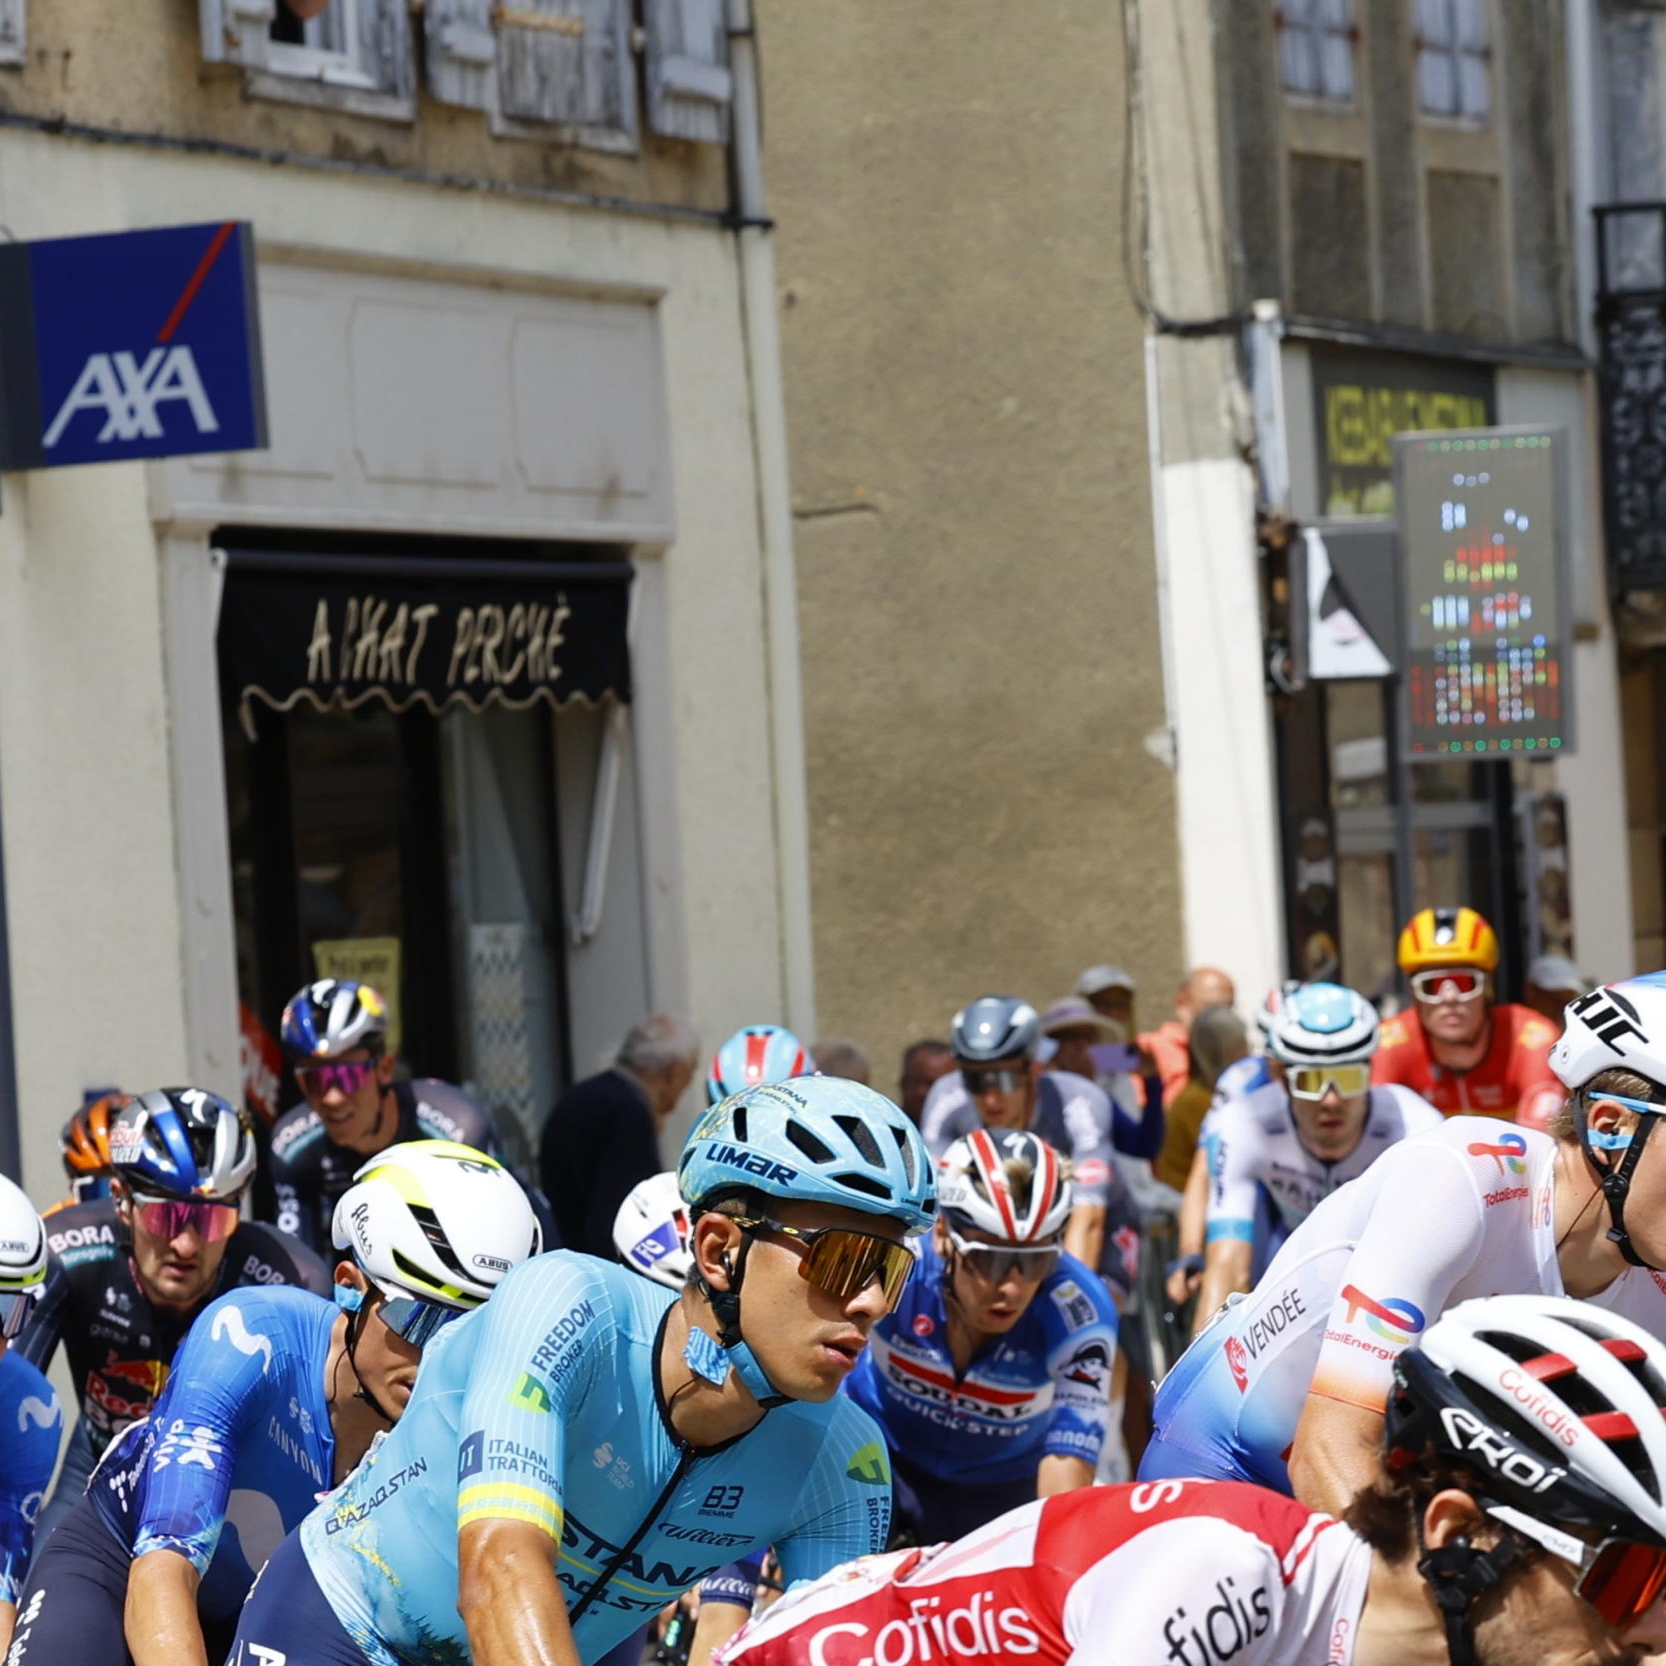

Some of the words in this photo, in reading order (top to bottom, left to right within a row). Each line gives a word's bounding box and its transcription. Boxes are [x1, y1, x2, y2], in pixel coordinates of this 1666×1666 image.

[43, 344, 220, 448] AXA
[307, 598, 332, 684] A
[1566, 985, 1650, 1059] HJC
[1481, 1186, 1531, 1208] TotalEnergies
[47, 1224, 117, 1255] BORA
[242, 1254, 288, 1286] BOR
[531, 1299, 596, 1372] FREEDOM
[1242, 1286, 1308, 1362] VENDÉE
[1325, 1327, 1401, 1362] otalEnergie
[549, 1339, 585, 1384] BROKER
[886, 1363, 1034, 1422] SOUDAL
[1498, 1368, 1580, 1449] Cofidis
[268, 1415, 324, 1487] CANYON
[488, 1438, 549, 1469] ITALIAN
[488, 1456, 564, 1496] TRATTORIA
[560, 1507, 723, 1588] STANA
[879, 1495, 890, 1554] FREE
